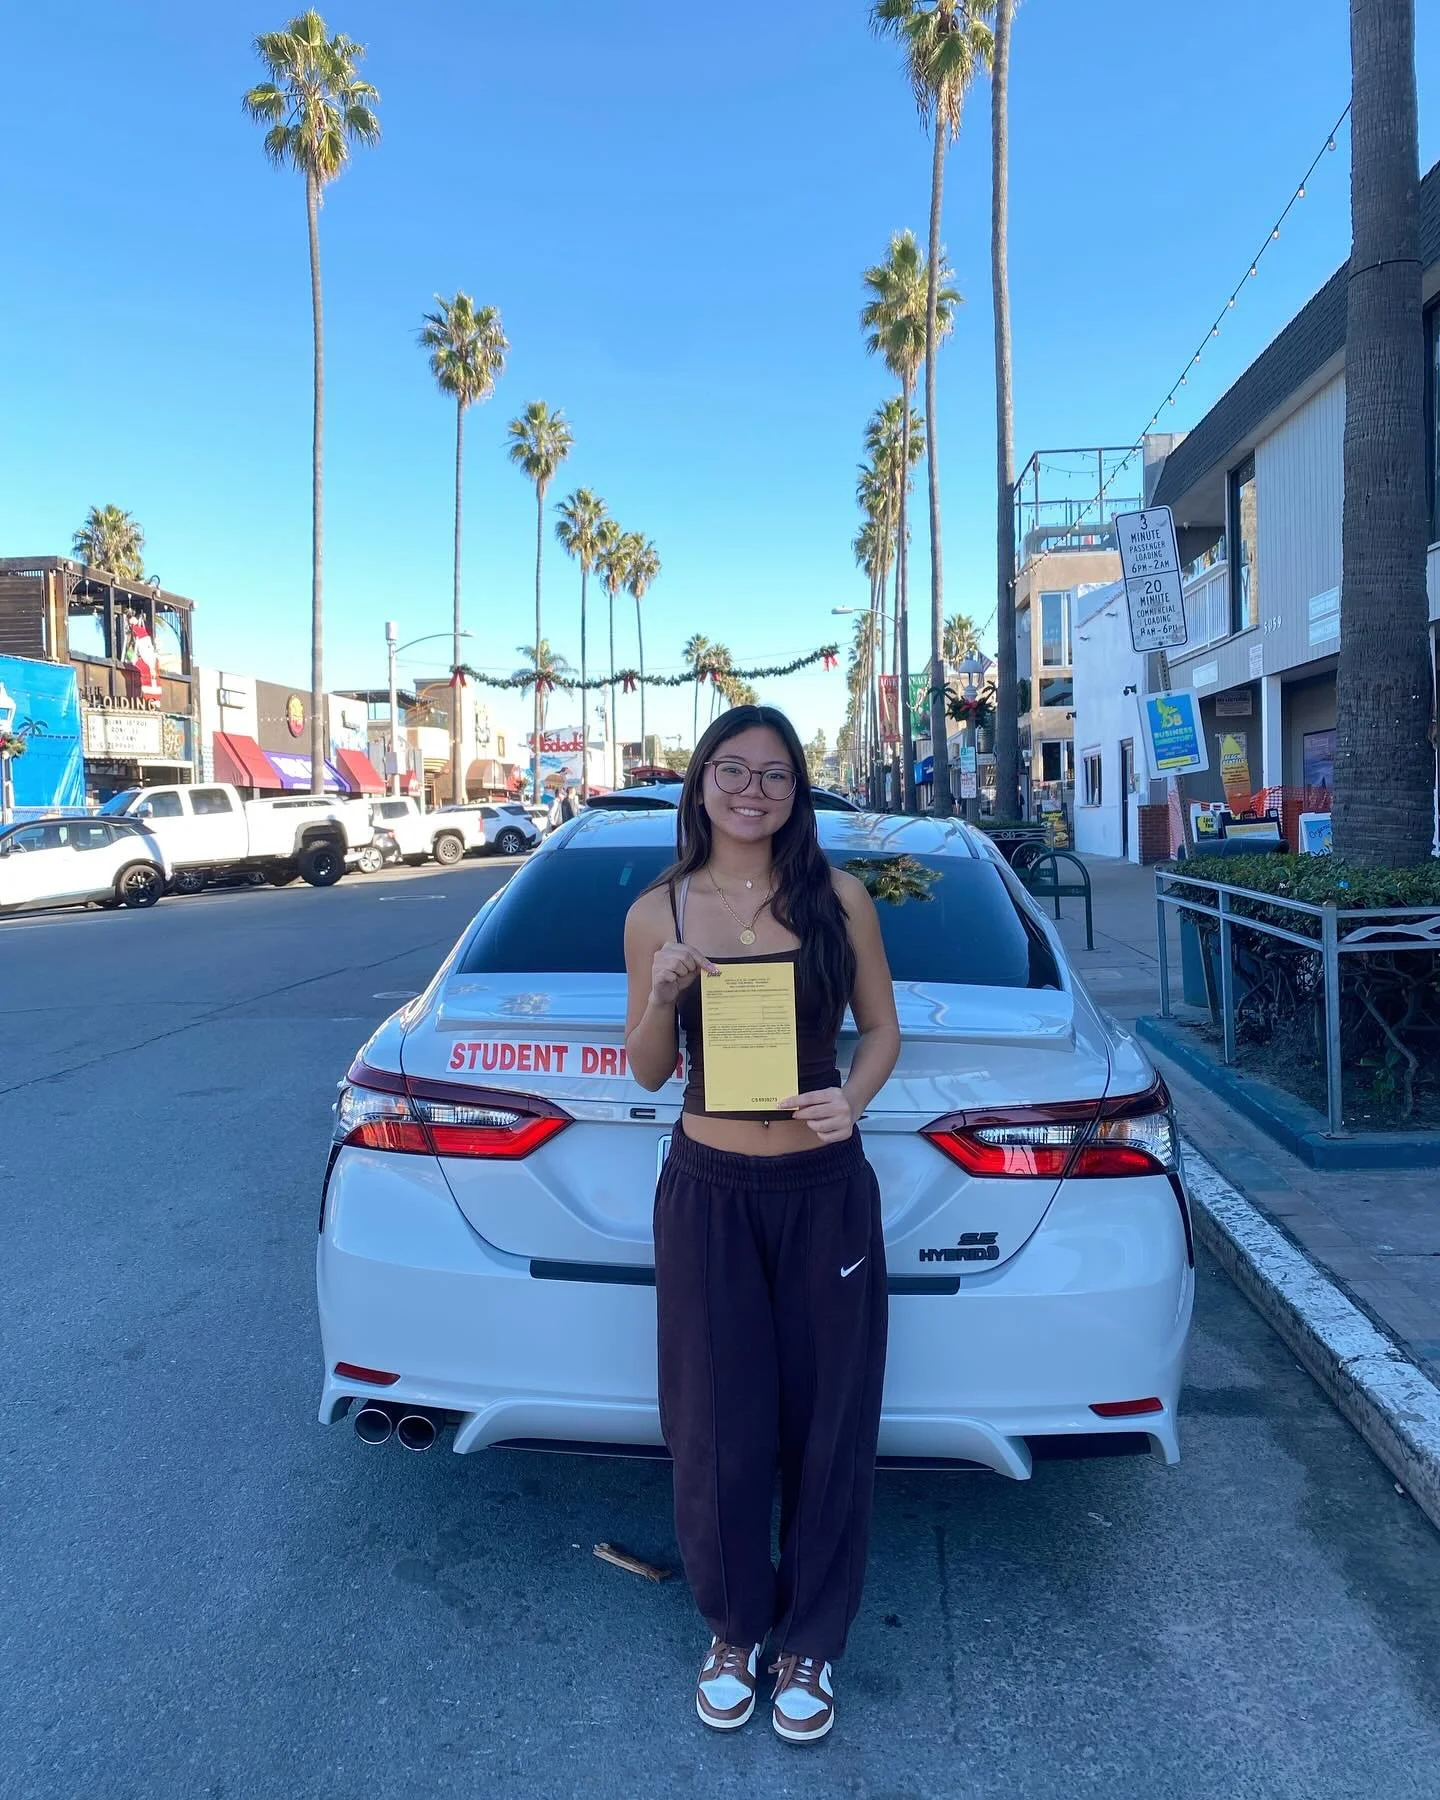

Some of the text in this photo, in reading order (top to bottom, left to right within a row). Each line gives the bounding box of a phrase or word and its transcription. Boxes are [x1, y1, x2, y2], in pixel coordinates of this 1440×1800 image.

[1140, 514, 1148, 530] 3
[1130, 529, 1161, 543] MINUTE
[1129, 541, 1166, 553] PASSENGER
[1135, 551, 1163, 562] LOADING
[1144, 580, 1162, 595] 20
[1140, 593, 1170, 606] MINUTE
[1136, 607, 1176, 619] COMMERCIAL
[1144, 616, 1172, 627] LOADING
[1154, 726, 1193, 740] BUSINESS
[449, 1042, 569, 1073] STUDENT
[919, 1247, 988, 1262] HYBRID
